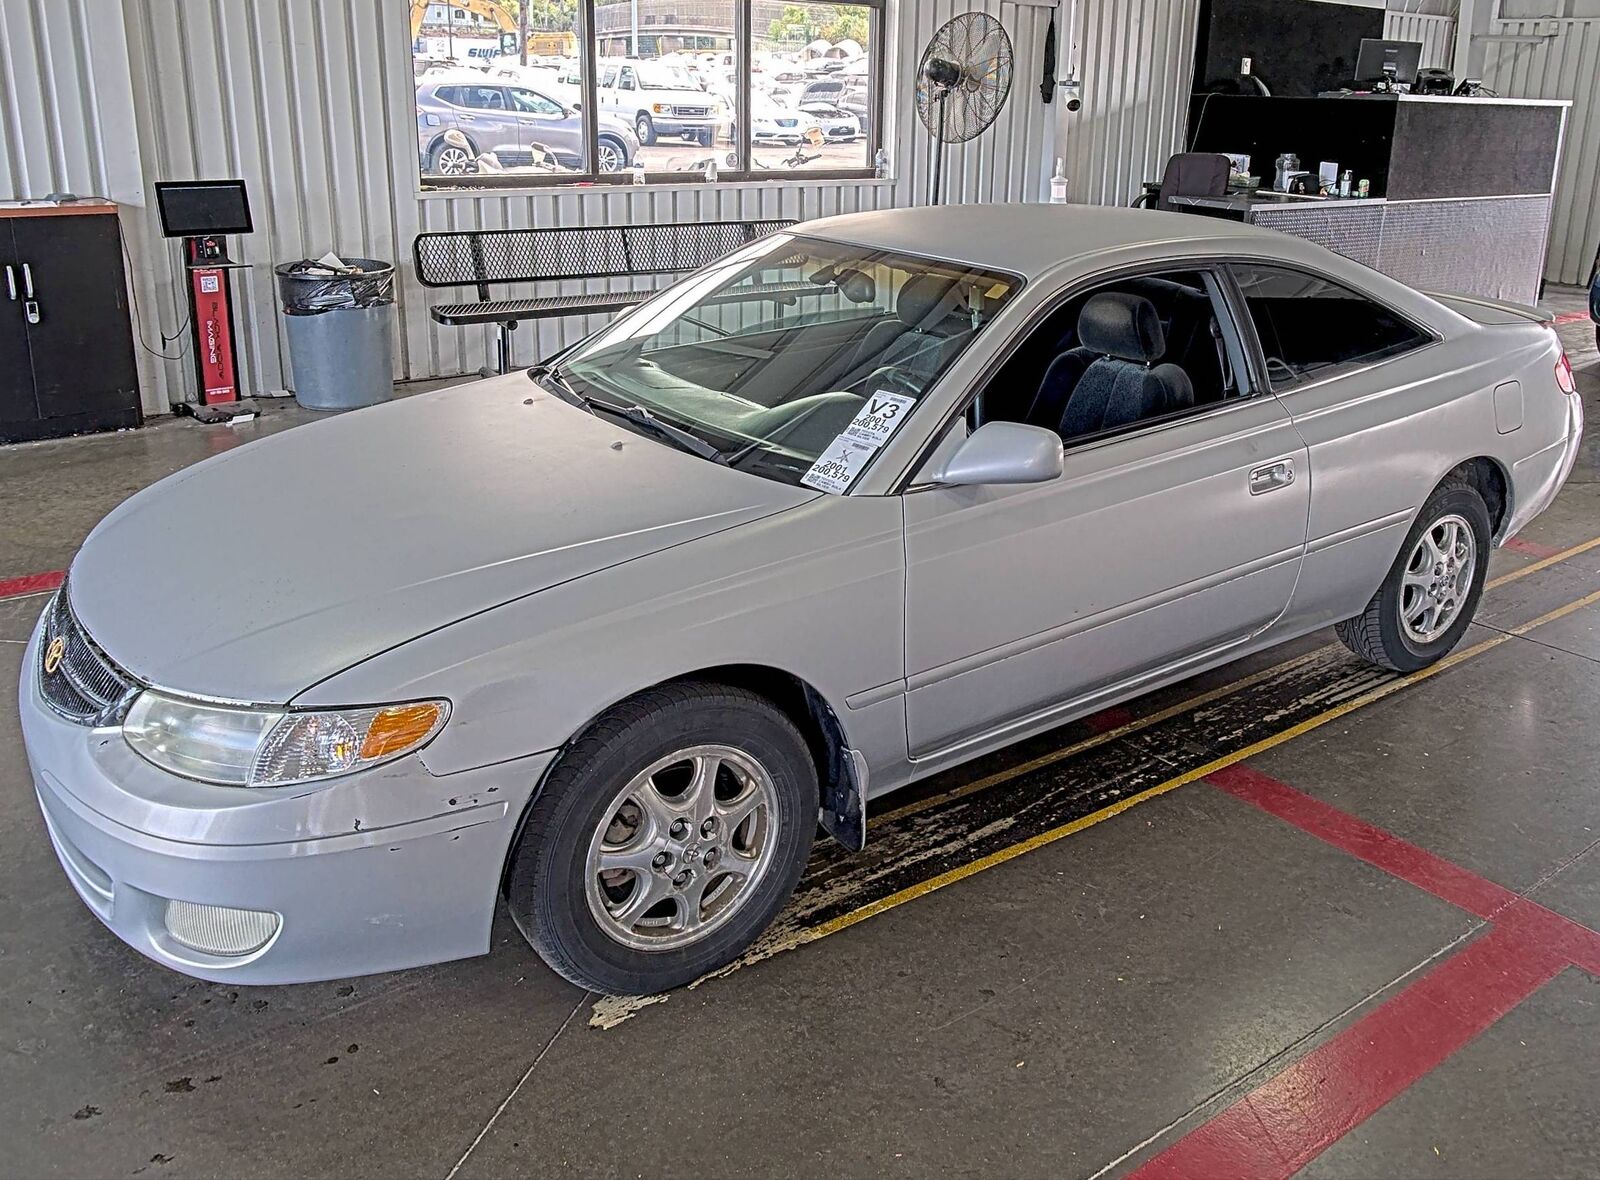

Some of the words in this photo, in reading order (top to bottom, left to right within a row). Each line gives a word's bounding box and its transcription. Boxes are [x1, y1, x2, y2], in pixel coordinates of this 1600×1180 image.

[468, 48, 502, 58] SWIF
[206, 320, 217, 364] IMAGING
[869, 398, 900, 419] V3
[852, 418, 890, 434] 200,579
[863, 414, 887, 426] 2001
[811, 464, 851, 483] 200,579
[824, 460, 848, 473] 2001
